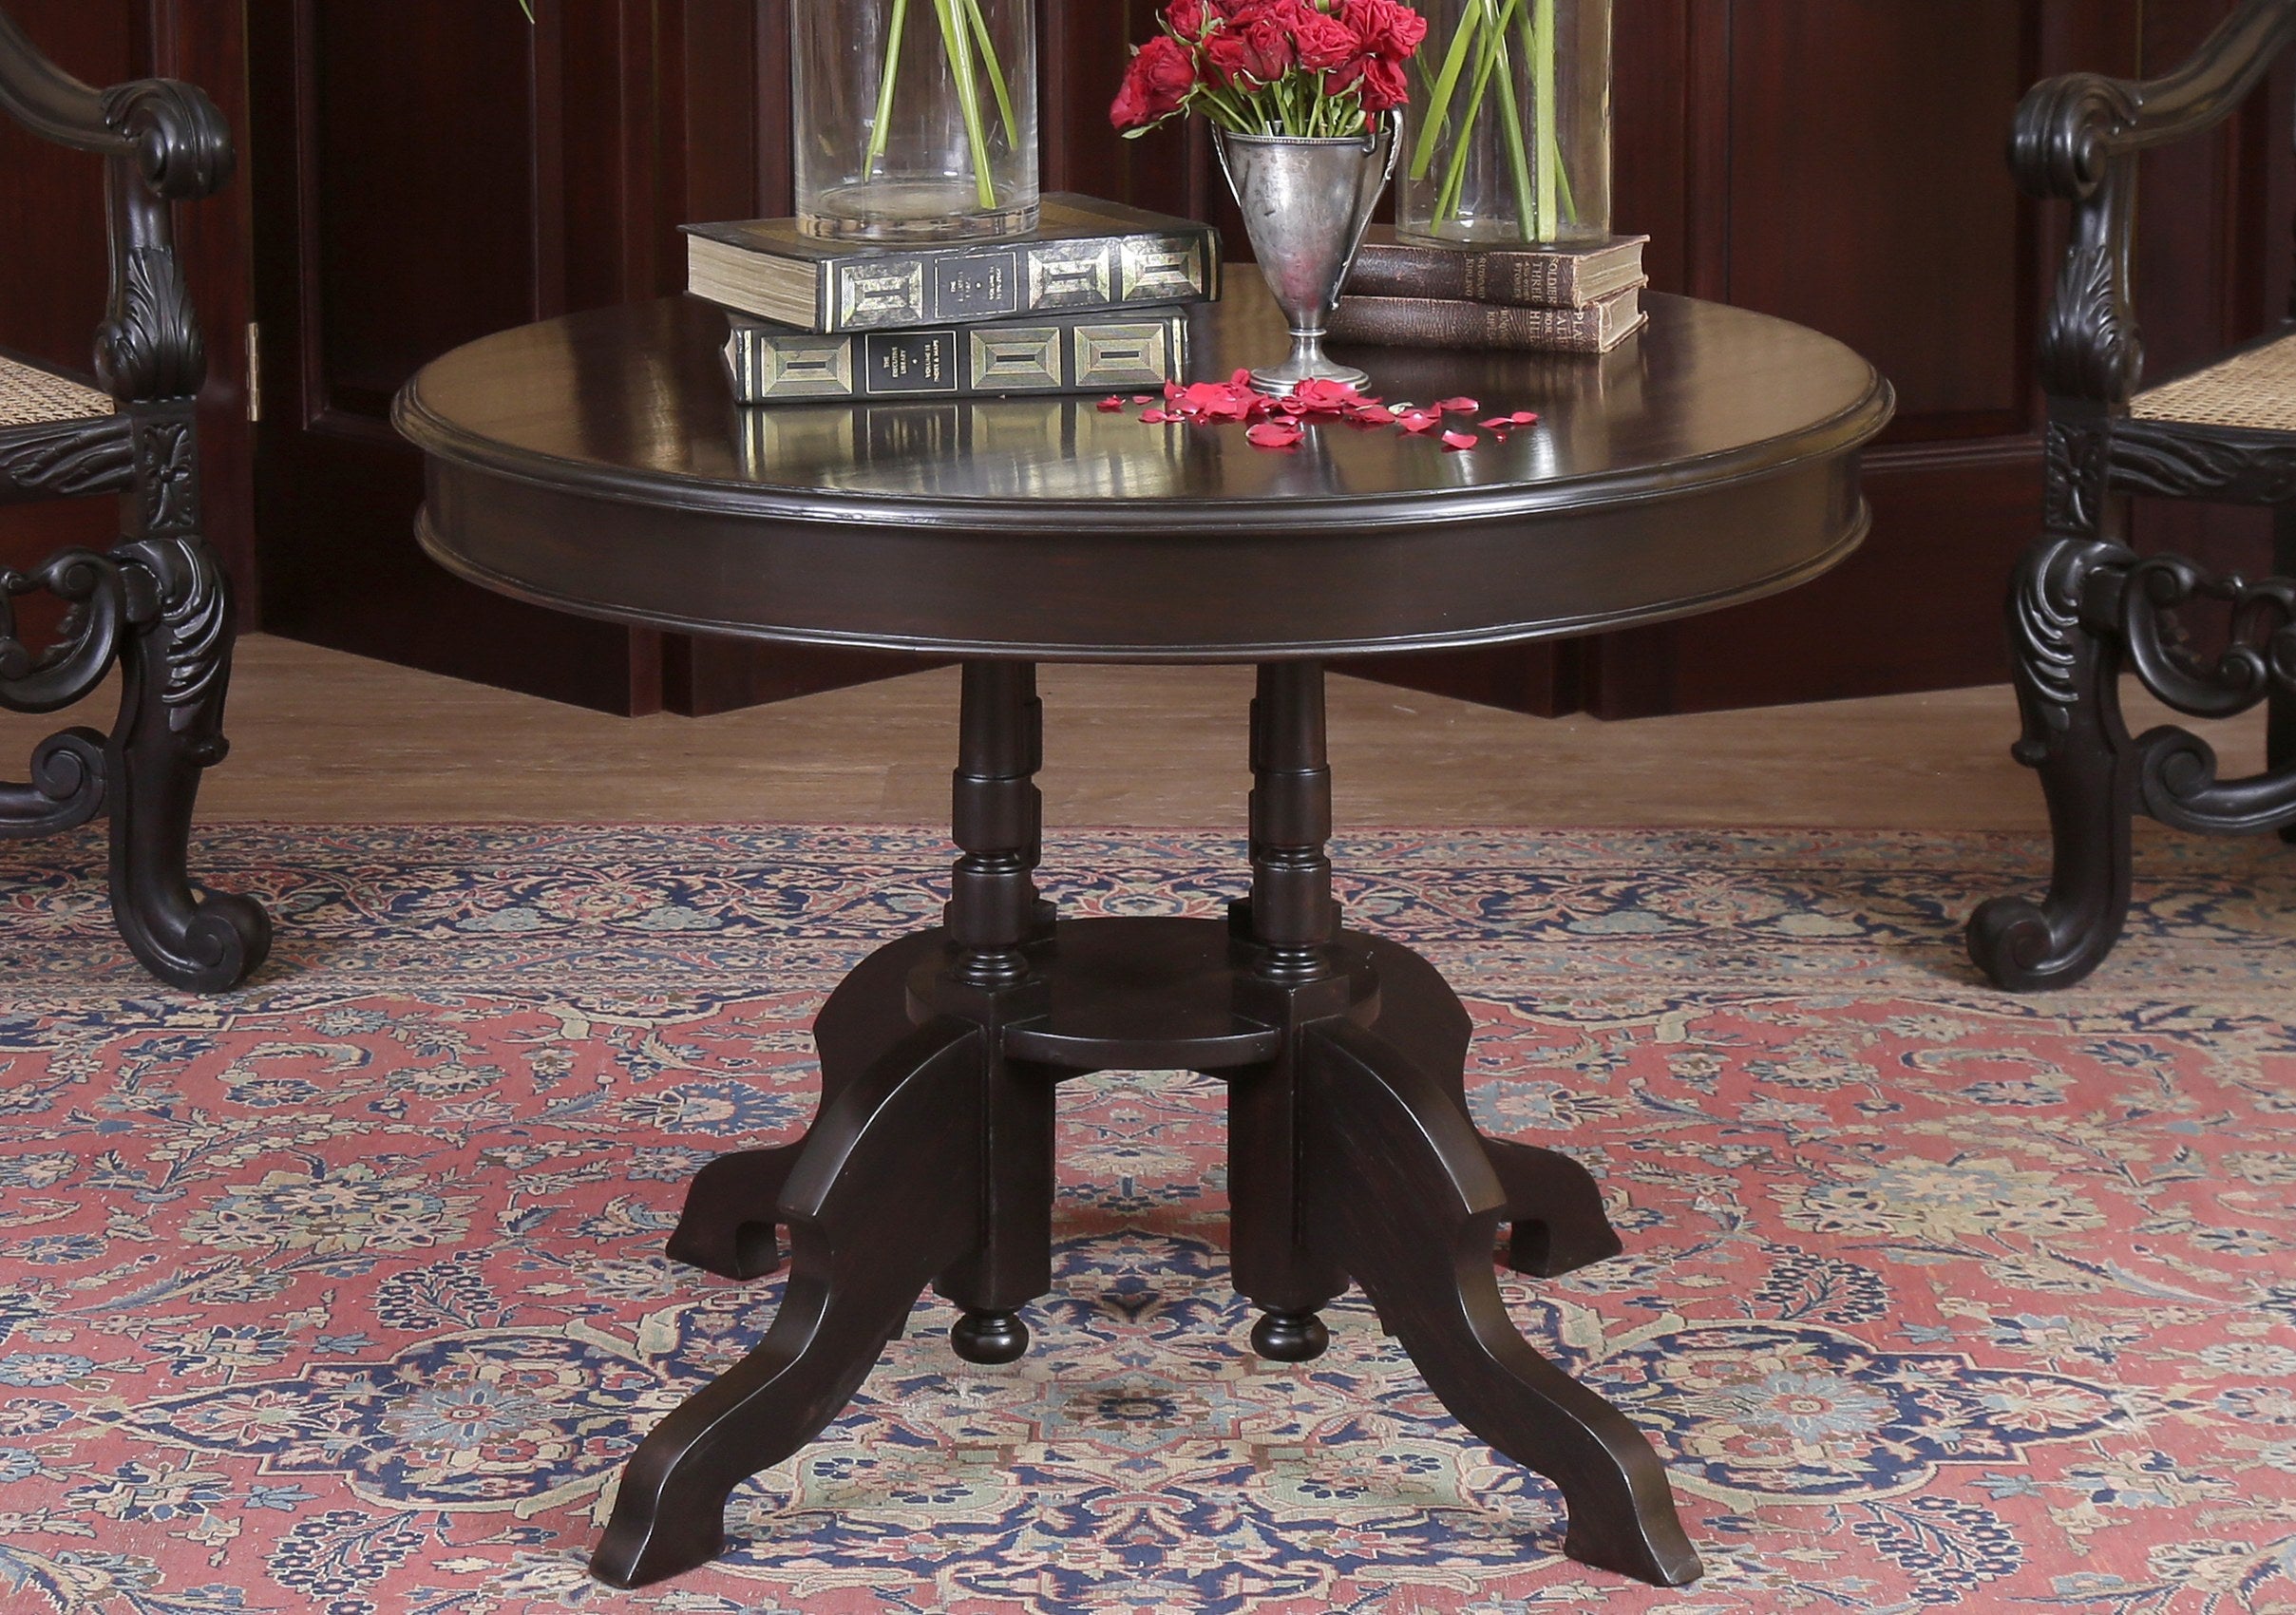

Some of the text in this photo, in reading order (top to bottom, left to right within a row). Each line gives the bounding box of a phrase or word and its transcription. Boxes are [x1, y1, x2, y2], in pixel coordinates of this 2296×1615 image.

[1530, 261, 1544, 304] THREE
[932, 339, 940, 357] MAPS
[882, 355, 891, 370] THE
[891, 346, 900, 378] EXECUTIVE
[900, 349, 908, 375] LIBRARY
